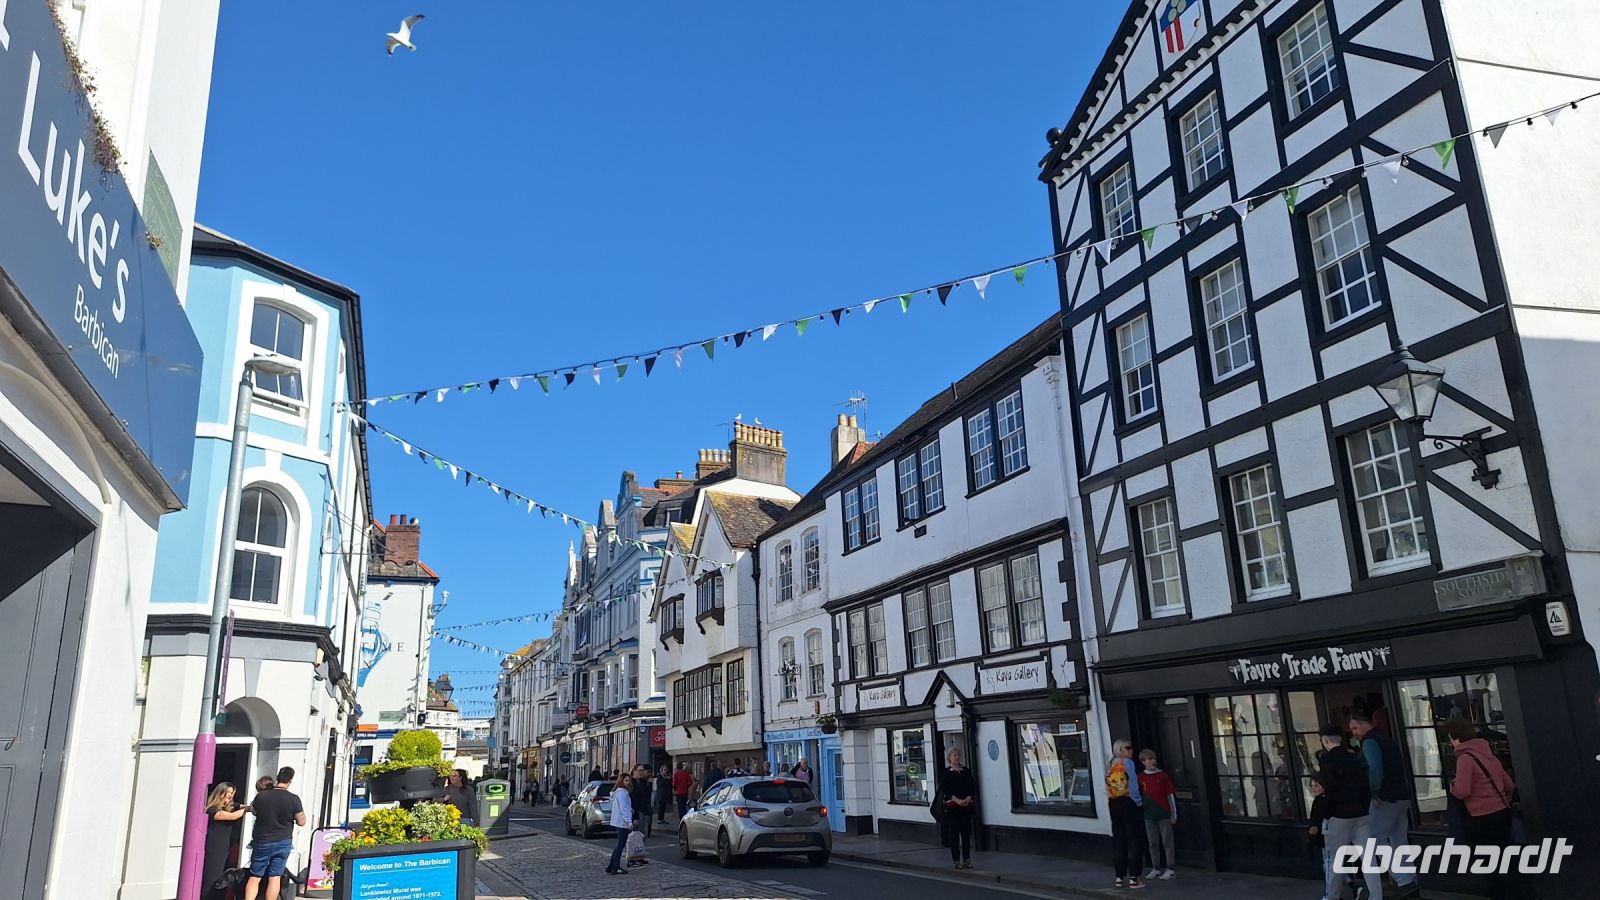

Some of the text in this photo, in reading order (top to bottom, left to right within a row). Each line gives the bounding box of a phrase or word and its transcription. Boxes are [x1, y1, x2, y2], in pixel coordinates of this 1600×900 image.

[18, 50, 129, 324] Luke's
[74, 283, 120, 380] Barbican
[995, 665, 1039, 686] Kaya Gallery
[1238, 646, 1374, 684] Fayre Trade Fairy
[869, 688, 896, 701] Kaya Gallery
[419, 858, 451, 866] Barbican
